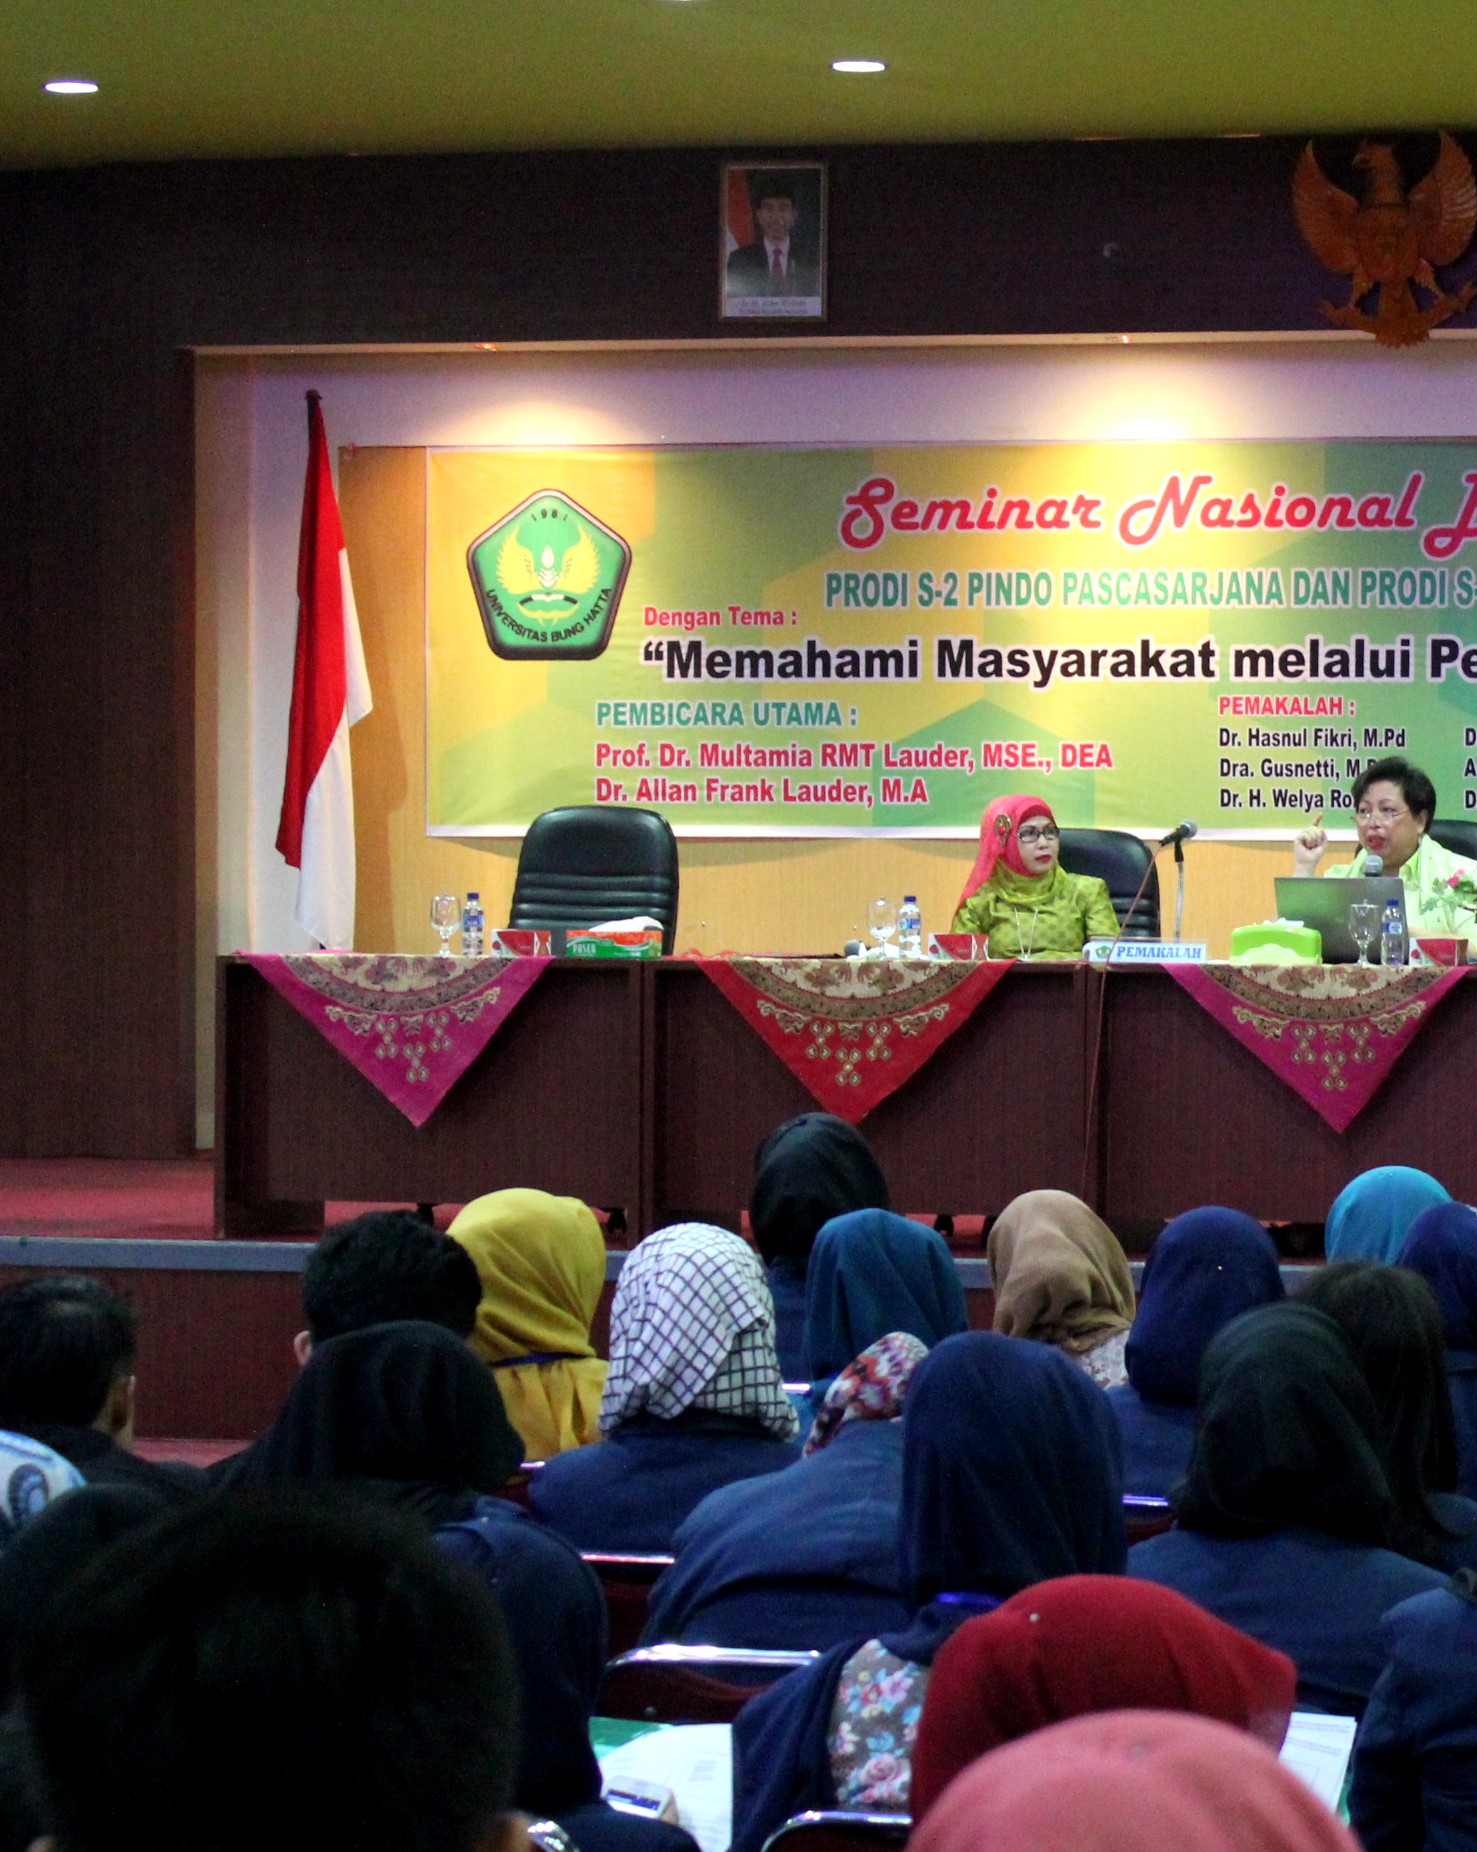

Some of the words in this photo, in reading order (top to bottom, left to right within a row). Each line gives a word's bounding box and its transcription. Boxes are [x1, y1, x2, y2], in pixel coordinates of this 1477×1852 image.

[531, 508, 568, 521] 1981
[841, 477, 1102, 549] Seminar
[1118, 473, 1422, 546] Nasional
[826, 572, 908, 607] PRODI
[918, 572, 958, 607] S-2
[968, 572, 1053, 607] PINDO
[1063, 570, 1283, 606] PASCASARJANA
[1294, 570, 1355, 606] DAN
[1361, 570, 1447, 606] PRODI
[486, 588, 549, 643] UNIVERSITAS
[550, 621, 585, 643] BUNG
[582, 587, 613, 628] HATTA
[644, 607, 721, 630] Dengan
[728, 606, 784, 626] Tema
[937, 639, 1216, 689] Masyarakat
[1233, 638, 1411, 678] melalui
[596, 702, 745, 726] PEMBICARA
[753, 702, 842, 726] UTAMA
[1218, 696, 1343, 715] PEMAKALAH
[1219, 728, 1241, 747] Dr.
[1248, 728, 1307, 747] Hasnul
[1313, 728, 1357, 751] Fikri,
[1364, 728, 1406, 747] M.Pd
[596, 743, 650, 767] Prof.
[660, 743, 691, 767] Dr.
[700, 743, 812, 767] Multamia
[821, 743, 875, 767] RMT
[884, 743, 974, 772] Lauder,
[982, 744, 1053, 772] MSE.,
[1060, 744, 1113, 768] DEA
[1220, 758, 1254, 777] Dra.
[1260, 757, 1340, 783] Gusnetti,
[596, 778, 628, 802] Dr.
[635, 778, 697, 802] Allan
[705, 778, 774, 802] Frank
[783, 778, 873, 808] Lauder,
[881, 778, 928, 802] M.A
[1220, 788, 1243, 808] Dr.
[1249, 788, 1267, 808] H.
[1272, 788, 1324, 813] Welya
[1330, 788, 1357, 808] Ro
[1116, 945, 1202, 959] PEMAKALAH
